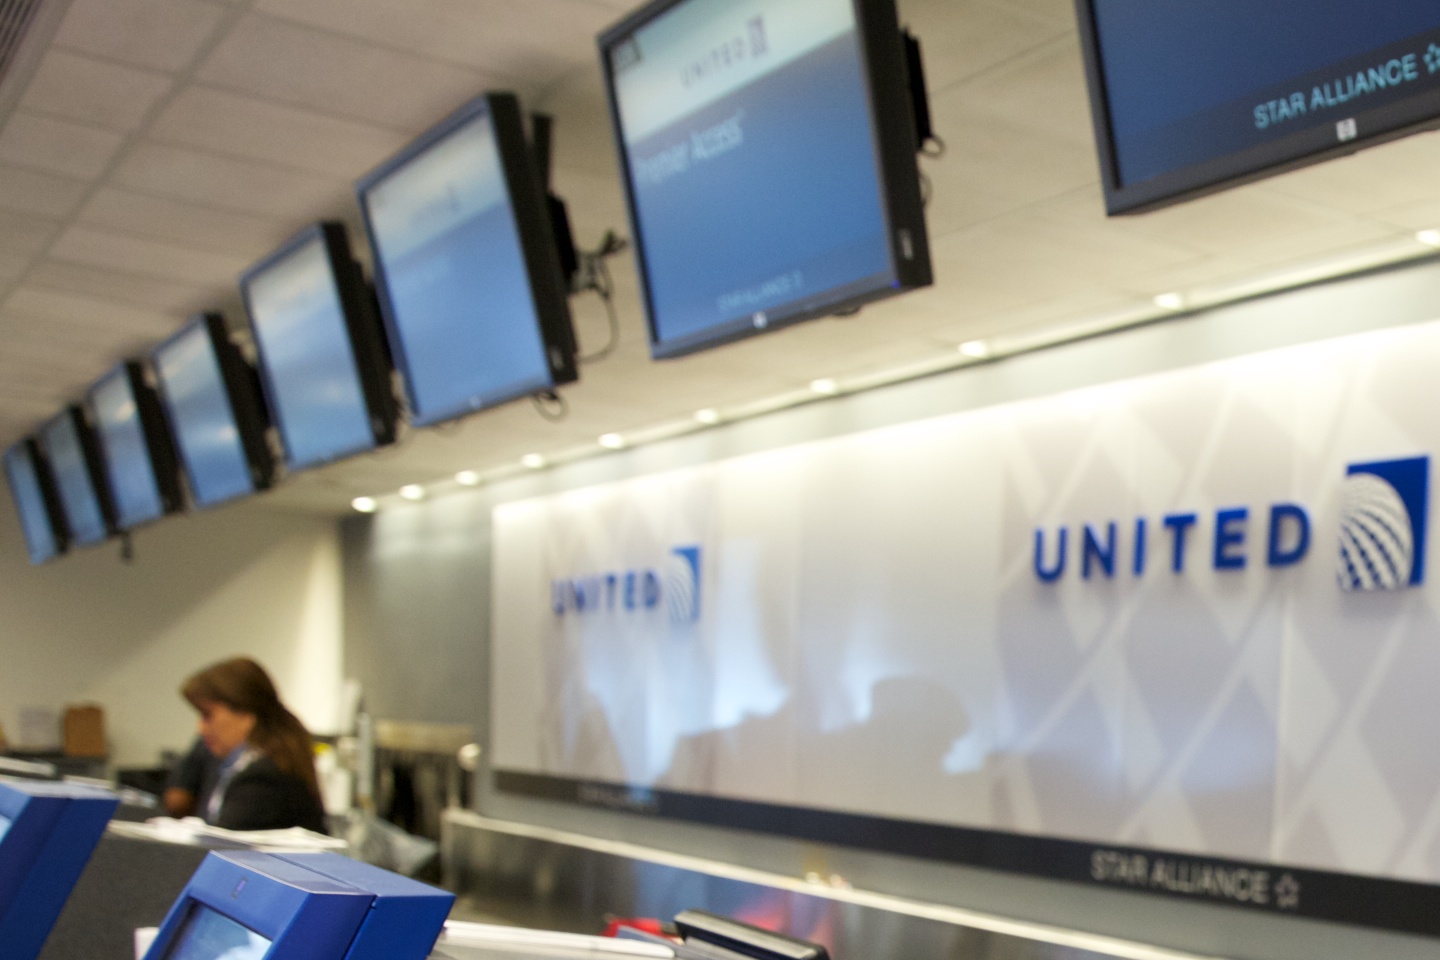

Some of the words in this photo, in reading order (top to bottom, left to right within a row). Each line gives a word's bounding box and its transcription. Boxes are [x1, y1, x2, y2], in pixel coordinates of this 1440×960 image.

[1253, 92, 1307, 130] STAR
[1310, 53, 1419, 110] ALLIANCE
[1034, 503, 1312, 584] UNITED
[551, 570, 662, 616] UNITED
[1090, 848, 1149, 884] STAR
[1152, 859, 1270, 904] ALLIANCE
